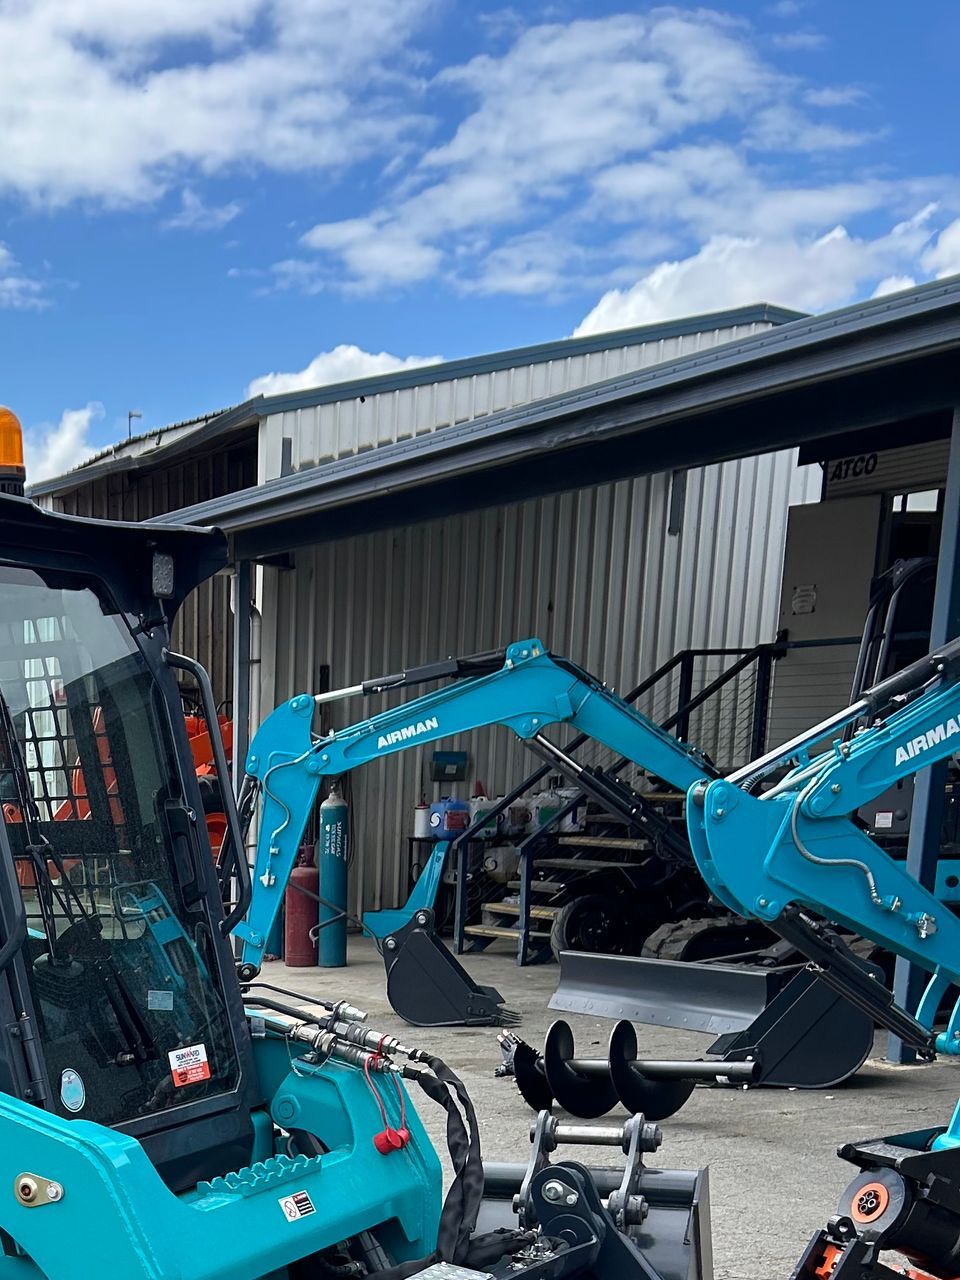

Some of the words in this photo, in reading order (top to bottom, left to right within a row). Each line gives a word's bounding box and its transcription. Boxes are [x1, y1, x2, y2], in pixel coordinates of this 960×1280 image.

[830, 453, 878, 482] ATCO
[377, 716, 439, 749] AIRMAN
[895, 714, 960, 767] AIRMA
[175, 1048, 200, 1062] SUNWARD
